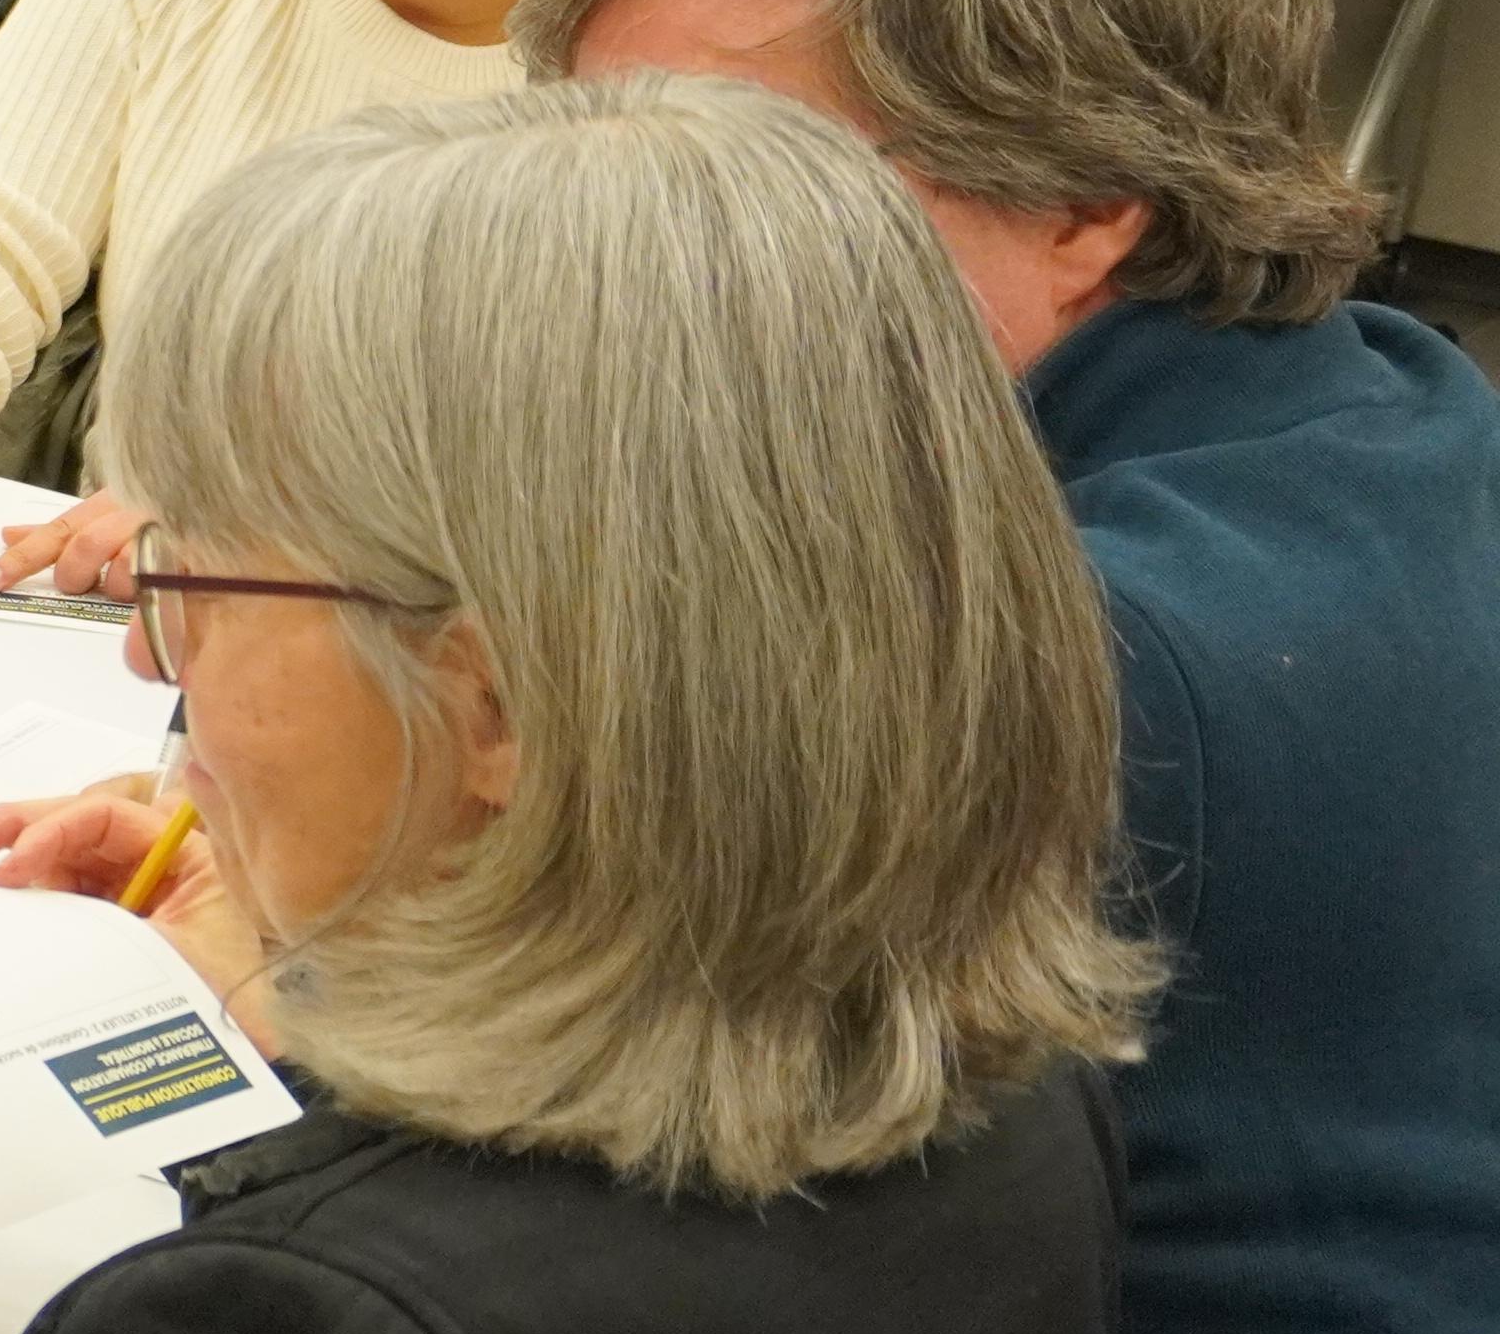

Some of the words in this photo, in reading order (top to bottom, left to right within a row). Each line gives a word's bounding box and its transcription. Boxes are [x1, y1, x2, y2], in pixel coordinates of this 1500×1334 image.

[158, 1024, 205, 1048] SOCIALE
[70, 1058, 148, 1094] COHABITATION
[150, 1065, 237, 1105] CONSULTATION
[93, 1091, 156, 1124] PUBLIQUE
